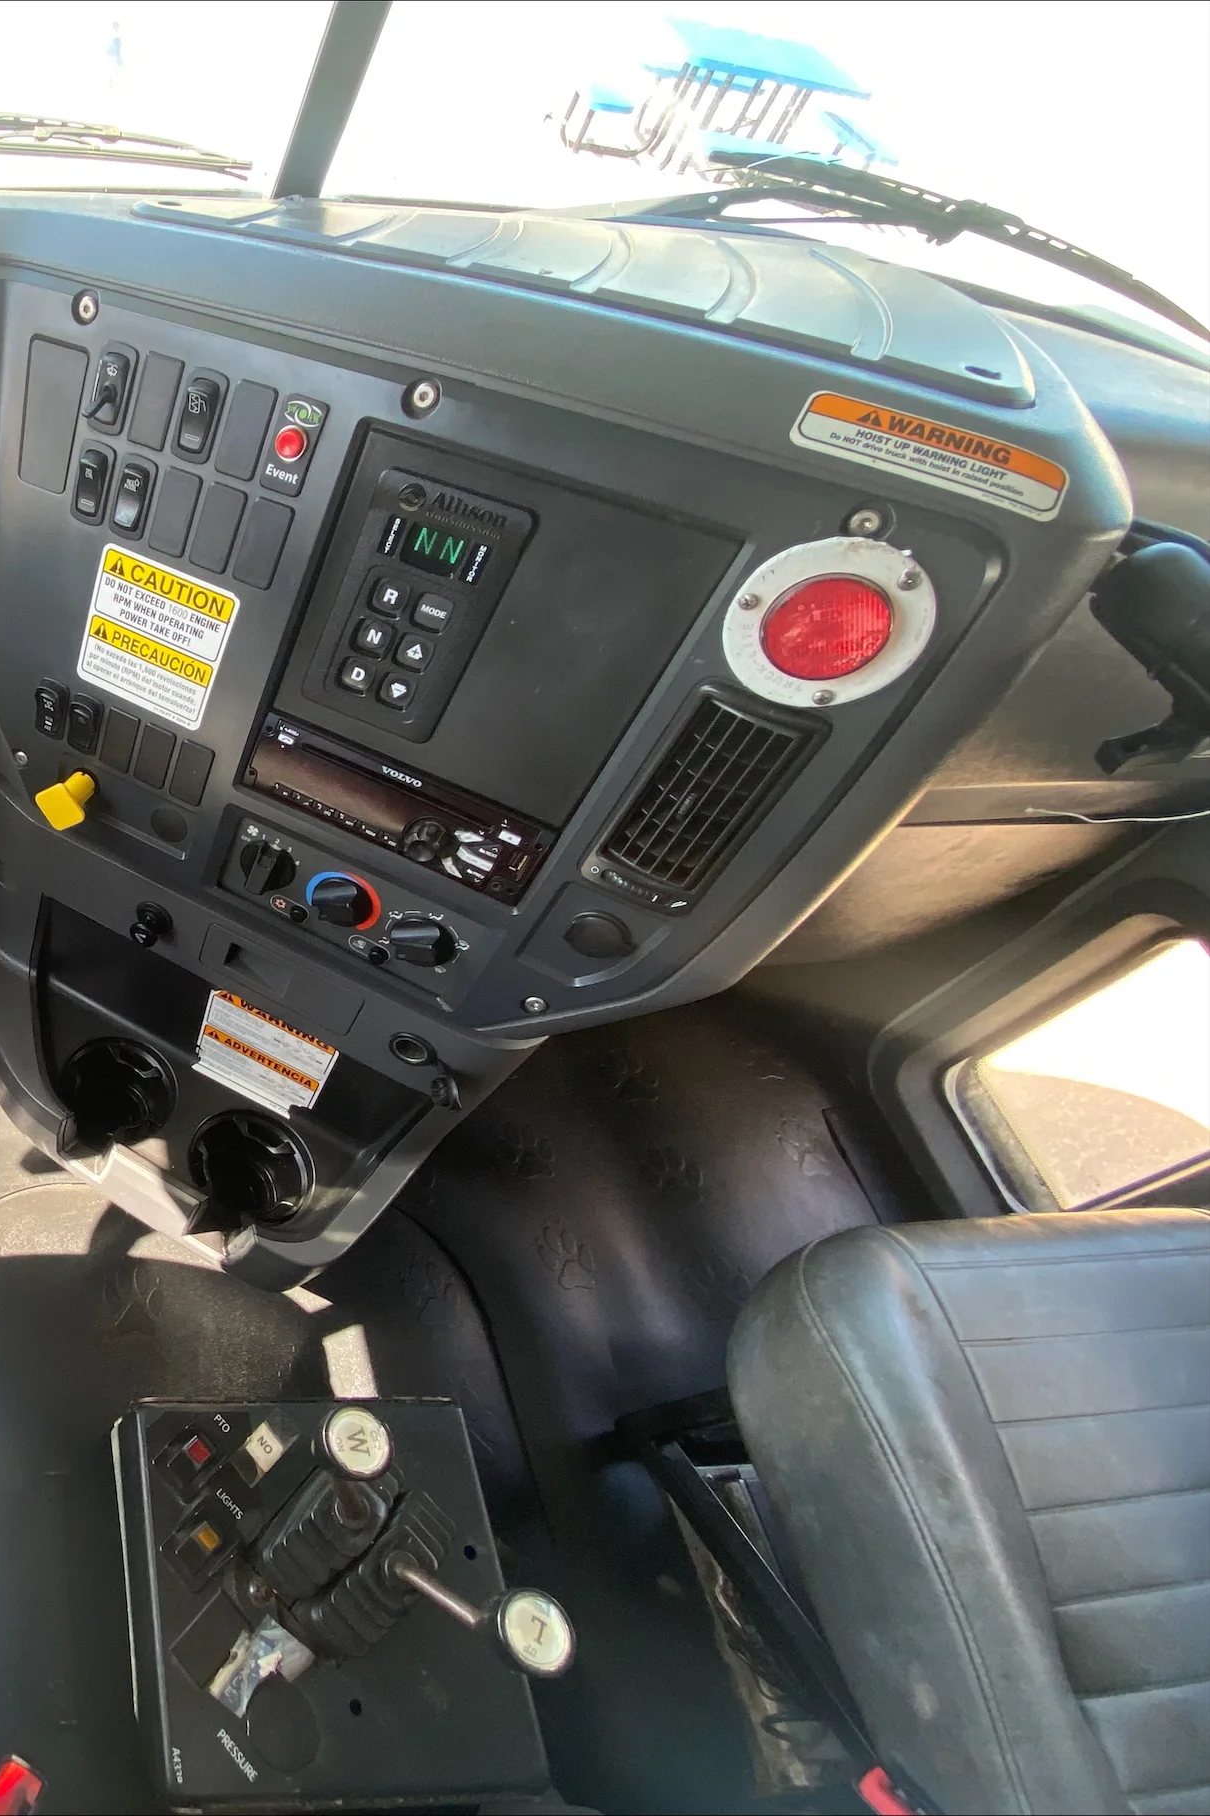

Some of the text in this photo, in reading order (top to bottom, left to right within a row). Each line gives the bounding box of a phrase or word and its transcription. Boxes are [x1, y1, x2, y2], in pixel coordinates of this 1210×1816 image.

[856, 429, 1007, 480] HOIST UP WARNING LIGHT
[889, 416, 1011, 464] WARNING
[265, 463, 299, 485] Event
[830, 433, 1024, 497] Do NOT drive truck with hoist in raised position
[384, 518, 401, 553] SELECT
[414, 527, 465, 564] N N
[466, 545, 487, 582] MONITOR
[105, 577, 221, 632] DO NOT EXCEED 1600 ENGINE
[130, 564, 226, 617] CAUTION
[383, 588, 399, 605] R
[113, 594, 205, 639] RPM WHEN OPERATING
[120, 608, 190, 646] POWER TAKE OFF!
[420, 604, 447, 619] MODE
[367, 629, 382, 645] N
[106, 648, 126, 662] exceda
[127, 657, 137, 667] las
[157, 672, 196, 695] revoluciones
[111, 630, 206, 683] PRECAUCIÓN
[351, 667, 366, 681] D
[120, 674, 147, 692] arranque
[148, 687, 158, 697] del
[121, 666, 141, 680] (RPM)
[152, 679, 170, 693] motor
[382, 765, 422, 788] VOLVO
[224, 1039, 312, 1088] ADVERTENCIA
[213, 1413, 231, 1433] PTO
[347, 1427, 371, 1457] W
[216, 1488, 244, 1520] LIGHTS
[531, 1614, 547, 1645] L
[217, 1729, 258, 1782] PRESSURE
